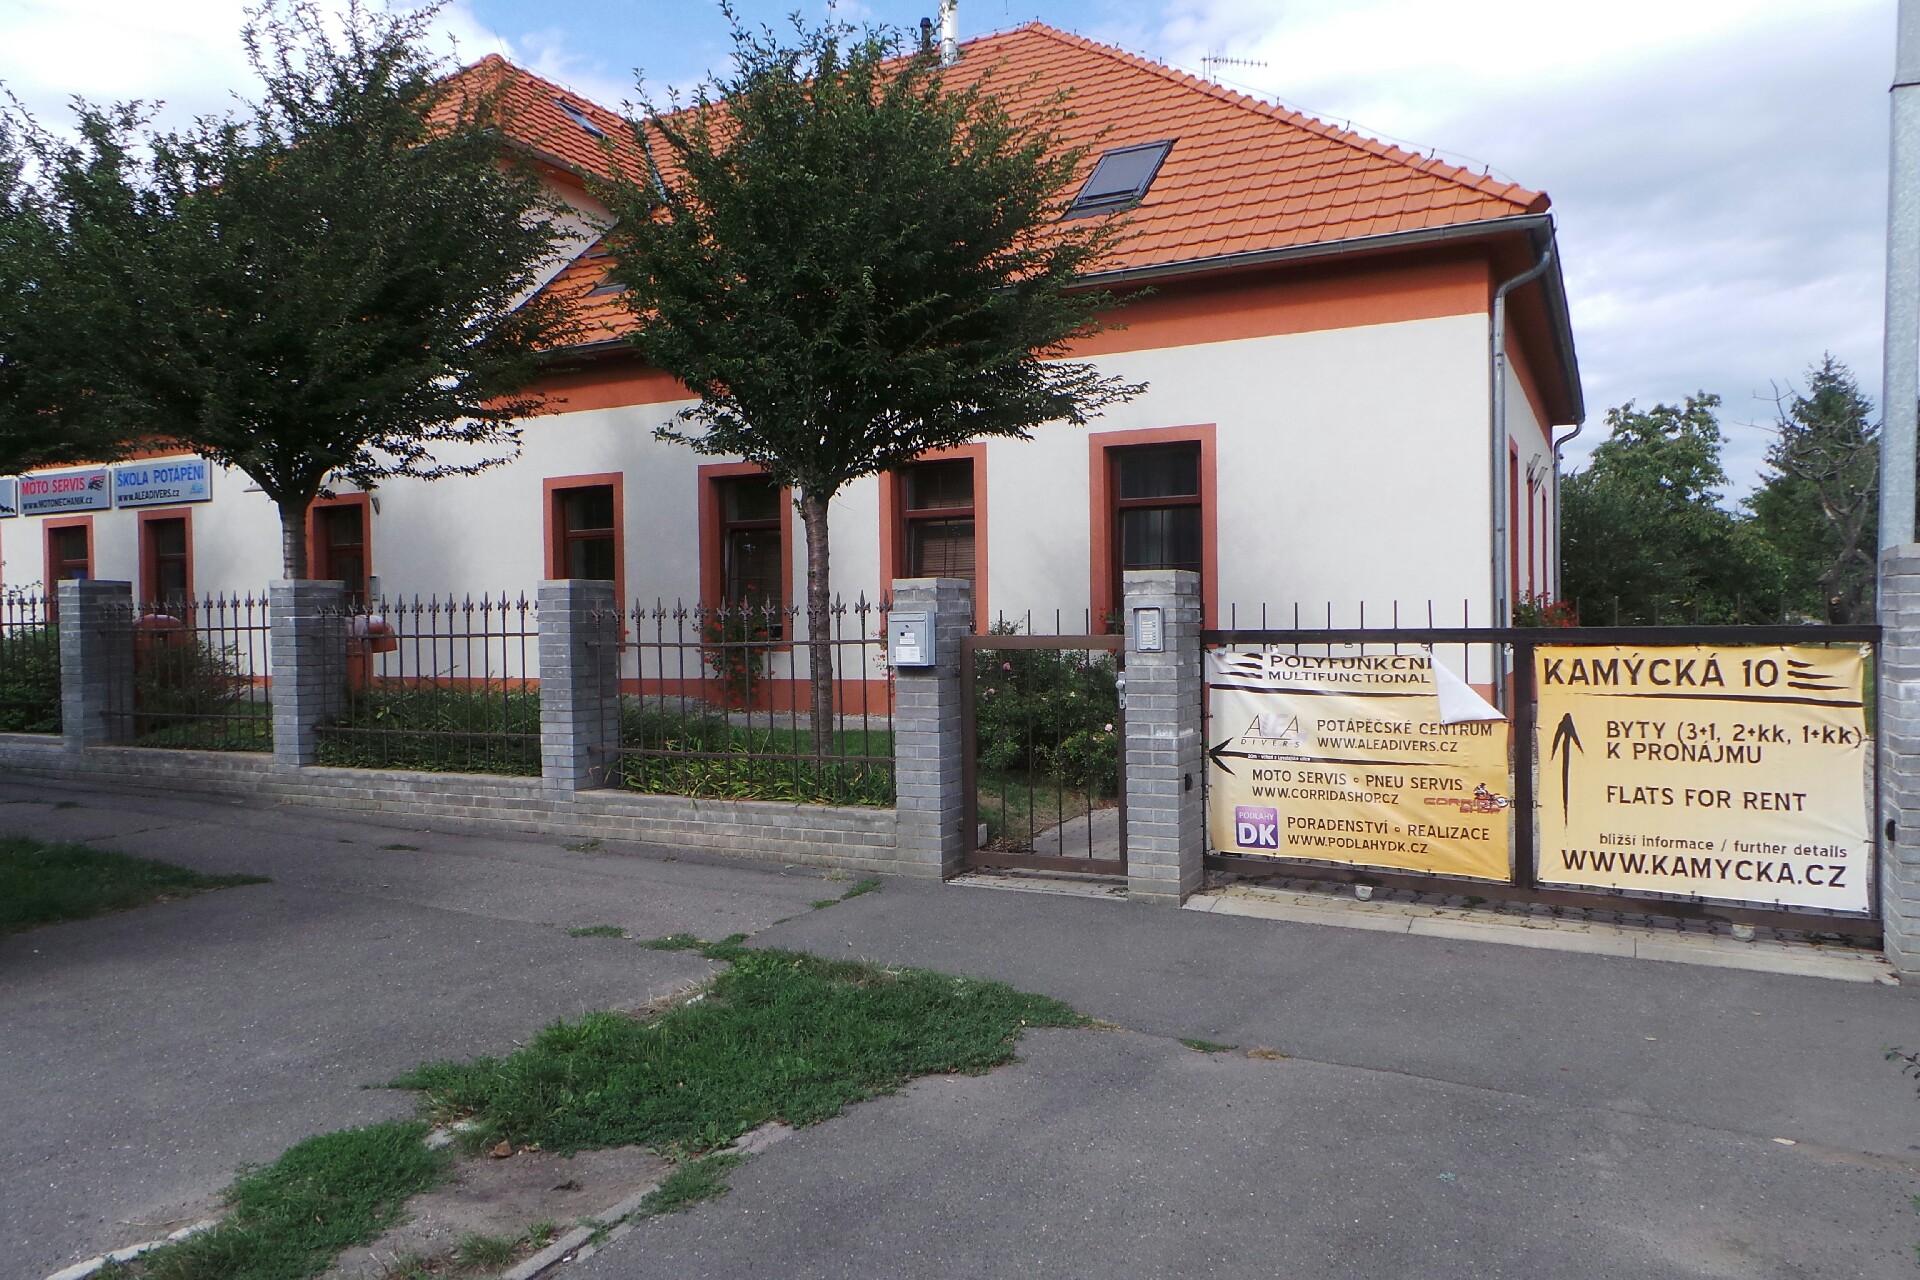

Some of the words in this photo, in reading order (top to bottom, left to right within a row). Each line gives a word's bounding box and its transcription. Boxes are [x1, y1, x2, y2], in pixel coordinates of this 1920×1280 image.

[22, 481, 48, 495] MOTO
[52, 477, 85, 493] SERVIS
[117, 470, 149, 487] ŠKOLA
[1268, 671, 1431, 684] MULTIFUNCTIONAL
[1543, 653, 1725, 687] KAMÝCKÁ
[1742, 659, 1779, 687] 10
[1317, 715, 1412, 735] POTÁPĚČSKÉ
[1419, 723, 1493, 736] CENTRUM
[1607, 721, 1666, 740] BYTY
[1733, 724, 1792, 746] 2+kk,
[1802, 725, 1863, 749] 1+kk)
[1241, 739, 1300, 748] DIVERS
[1318, 737, 1458, 753] WWW.ALEADIVERS.CZ
[1607, 742, 1621, 759] K
[1633, 738, 1762, 764] PRONÁJMU
[1252, 769, 1292, 782] MOTO
[1298, 771, 1347, 785] SERVIS
[1366, 774, 1404, 789] PNEU
[1411, 776, 1463, 791] SERVIS
[1252, 786, 1399, 805] WWW.CORRIDASHOP.CZ
[1607, 785, 1674, 806] FLATS
[1684, 788, 1731, 809] FOR
[1744, 791, 1807, 812] RENT
[1239, 811, 1275, 821] PODLAHY
[1238, 823, 1277, 846] DK
[1287, 815, 1389, 835] PORADENSTVÍ
[1407, 824, 1490, 841] REALIZACE
[1288, 834, 1428, 854] WWW.PODLAHYDK.CZ
[1599, 832, 1637, 847] bližší
[1642, 834, 1714, 851] informace
[1734, 840, 1787, 855] further
[1794, 843, 1848, 858] details
[1562, 850, 1848, 888] WWW.KAMYCKA.CZ
